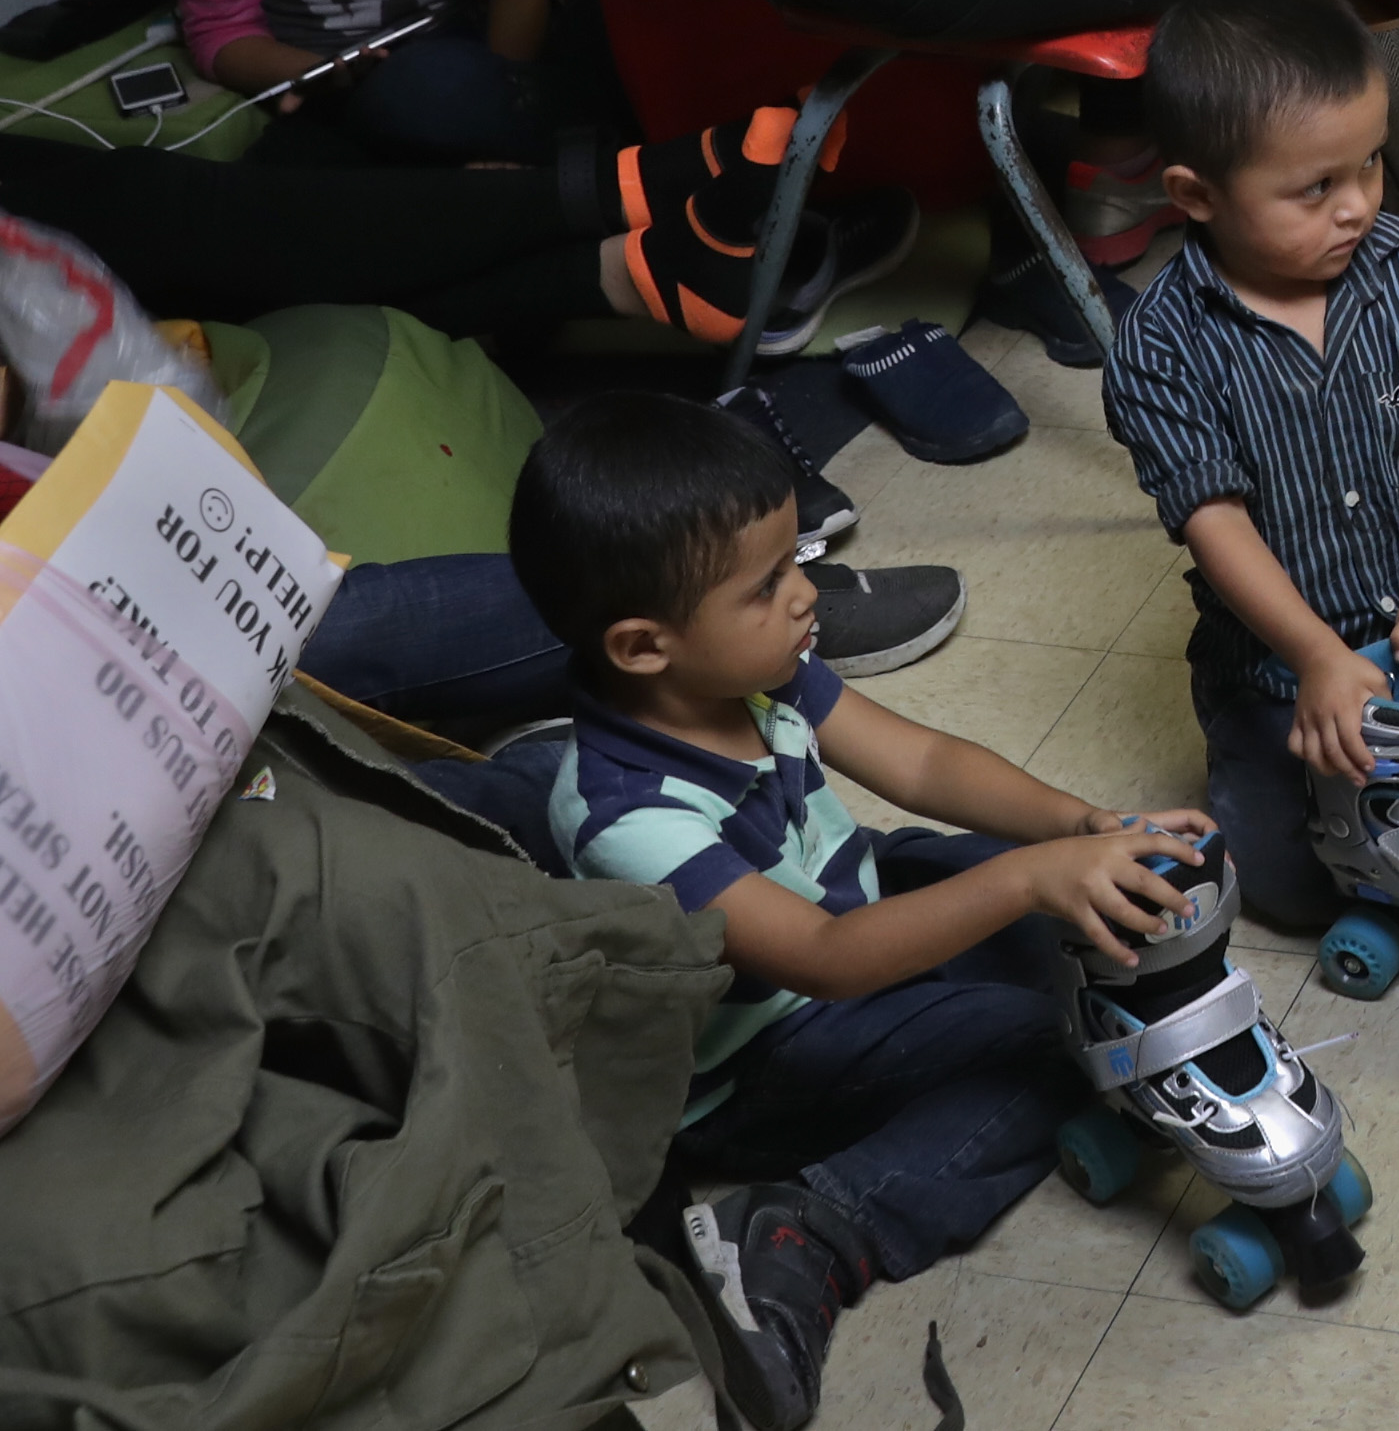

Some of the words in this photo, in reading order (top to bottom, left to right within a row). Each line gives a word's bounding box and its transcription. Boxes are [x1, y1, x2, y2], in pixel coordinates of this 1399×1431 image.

[155, 504, 220, 585] FOR
[233, 526, 314, 631] HELP!
[89, 575, 180, 686] TAKE?
[215, 578, 272, 655] YOU
[95, 660, 146, 723] DO
[178, 676, 217, 735] TO
[143, 714, 198, 792] BUS
[63, 864, 116, 940] NOT
